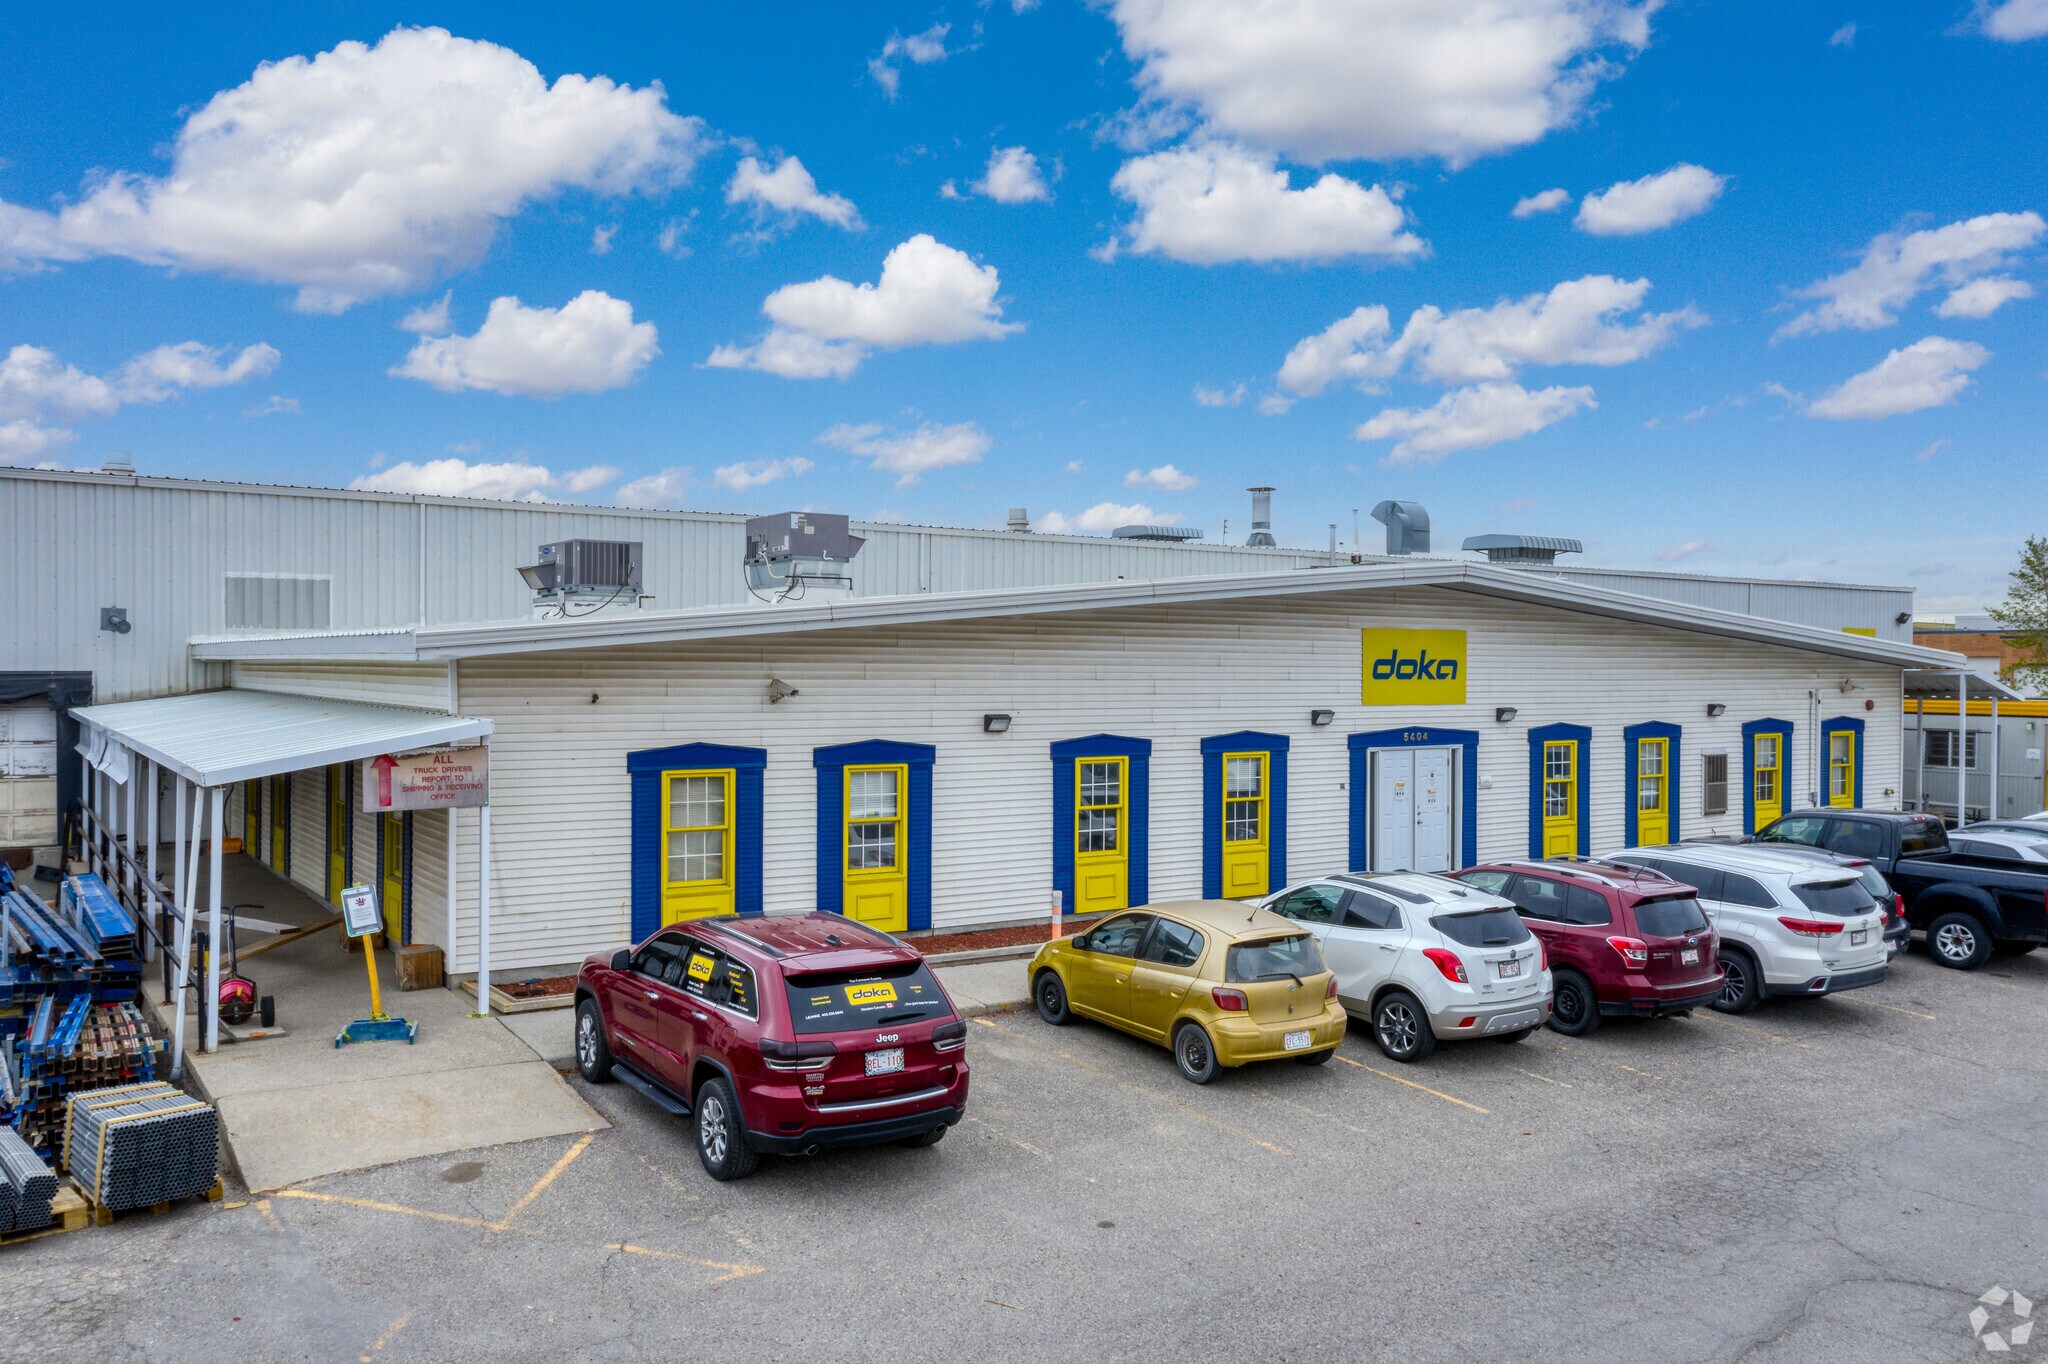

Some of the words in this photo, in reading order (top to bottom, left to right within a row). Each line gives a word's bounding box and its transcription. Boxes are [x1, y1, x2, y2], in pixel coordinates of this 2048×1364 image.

[1372, 649, 1458, 680] doka
[1403, 732, 1428, 742] 5404
[433, 755, 454, 765] ALL
[442, 765, 473, 773] DRIVERS
[421, 775, 451, 783] REPORT
[402, 785, 435, 793] SHIPPING
[446, 783, 483, 791] RECEIVING
[430, 793, 456, 801] OFFICE
[691, 961, 710, 975] doka
[852, 988, 891, 999] doka
[876, 1033, 899, 1043] Jeep
